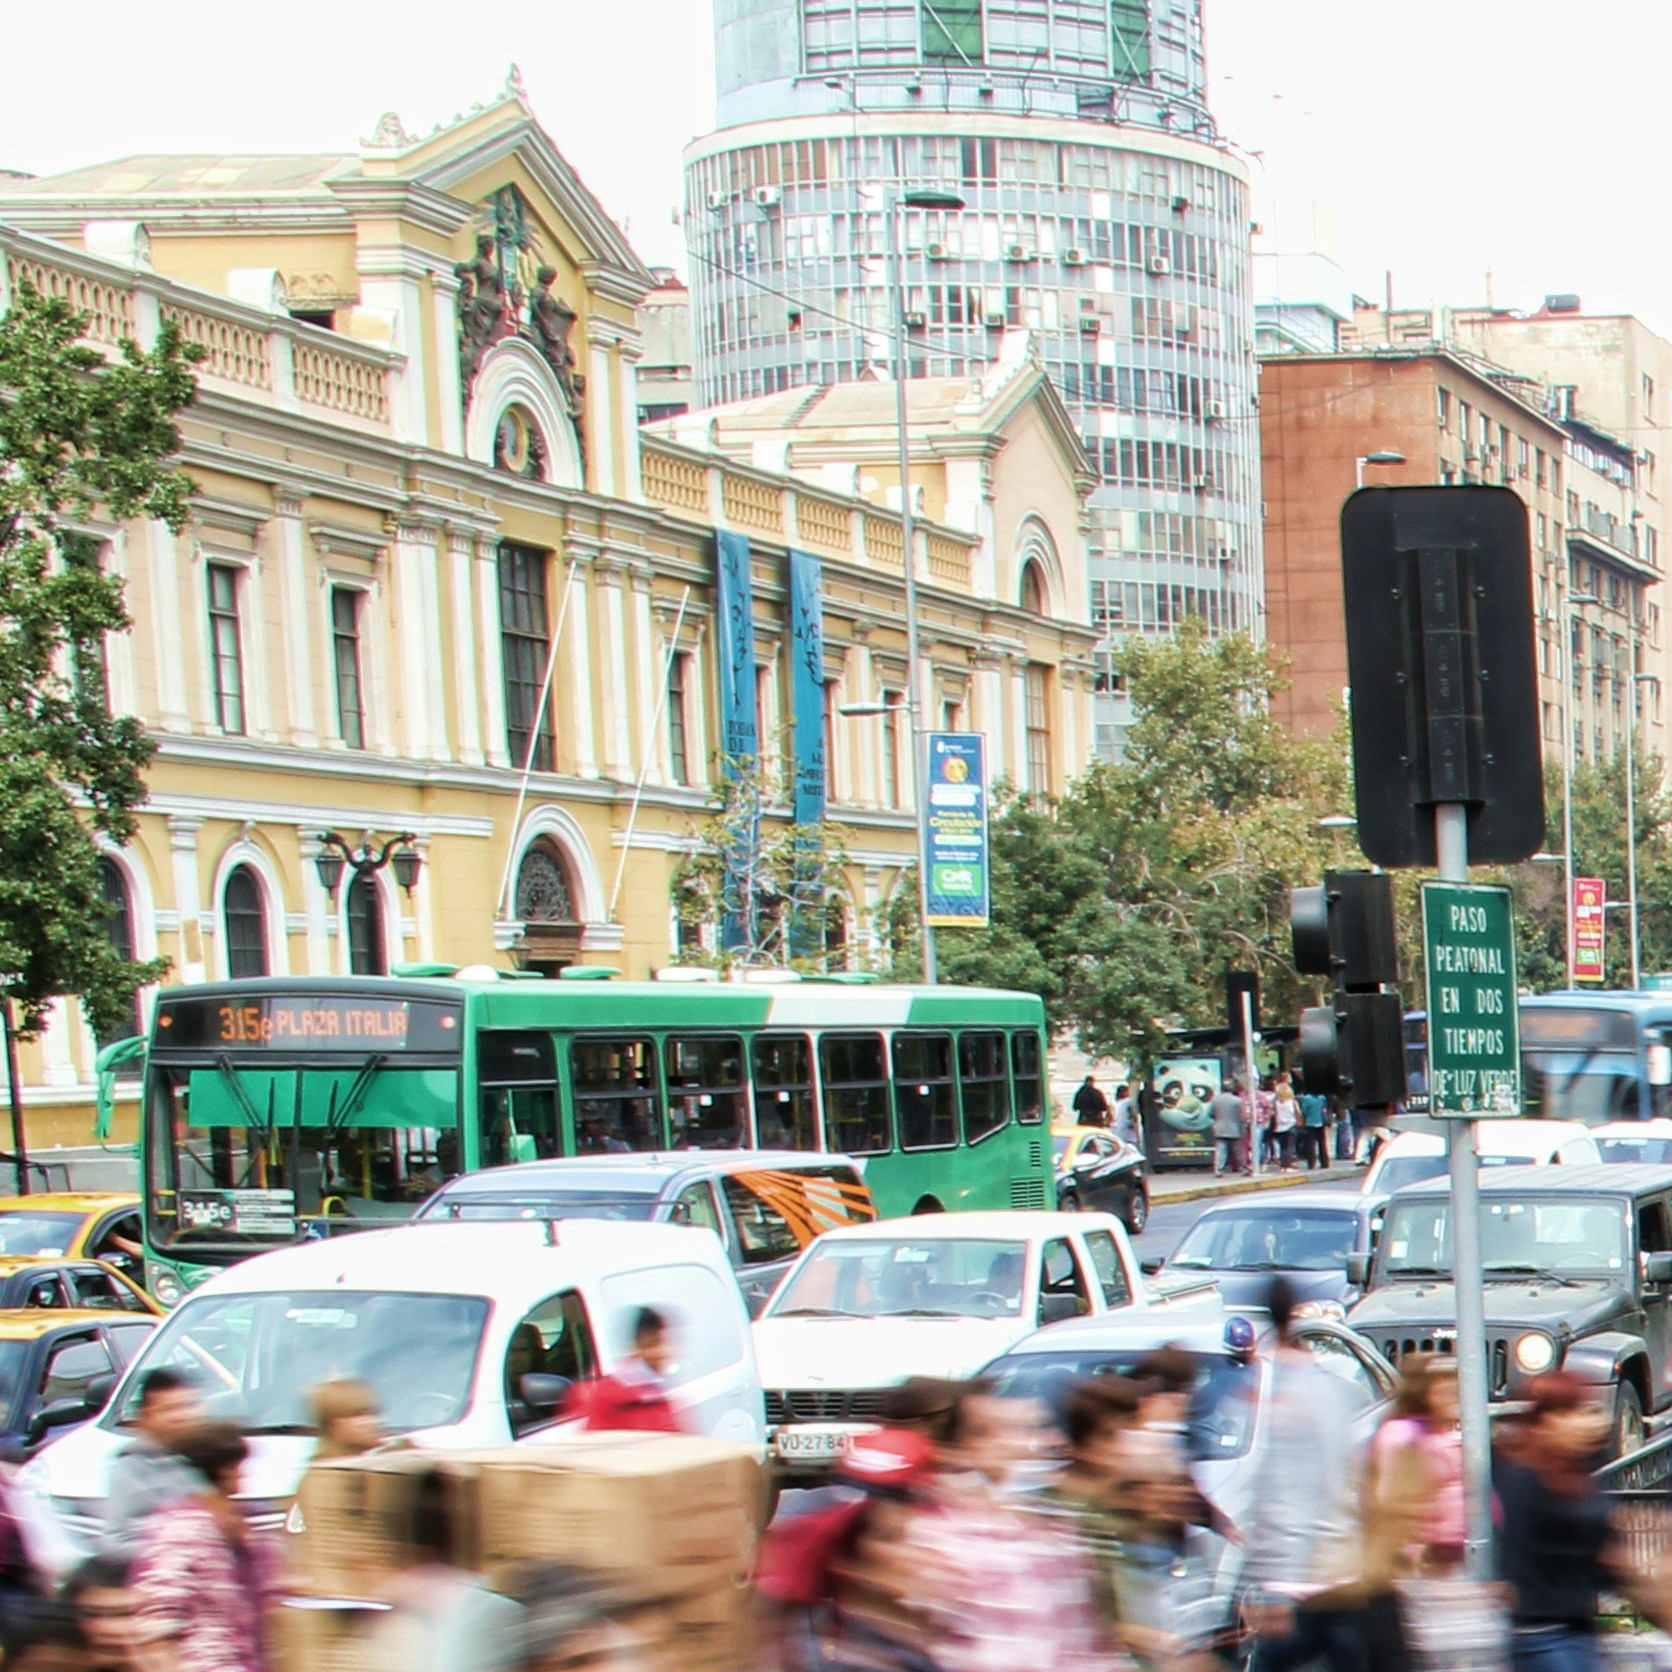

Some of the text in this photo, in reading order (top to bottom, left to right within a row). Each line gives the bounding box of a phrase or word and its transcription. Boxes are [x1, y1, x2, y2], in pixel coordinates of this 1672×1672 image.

[1450, 905, 1488, 933] PASO
[1435, 945, 1506, 975] PEATONAL
[1441, 987, 1504, 1015] EN DOS
[219, 1006, 407, 1041] 315e PLAZA ITALIA
[1443, 1028, 1505, 1056] TIEMPOS
[1433, 1069, 1518, 1096] DE LUZ VERDE
